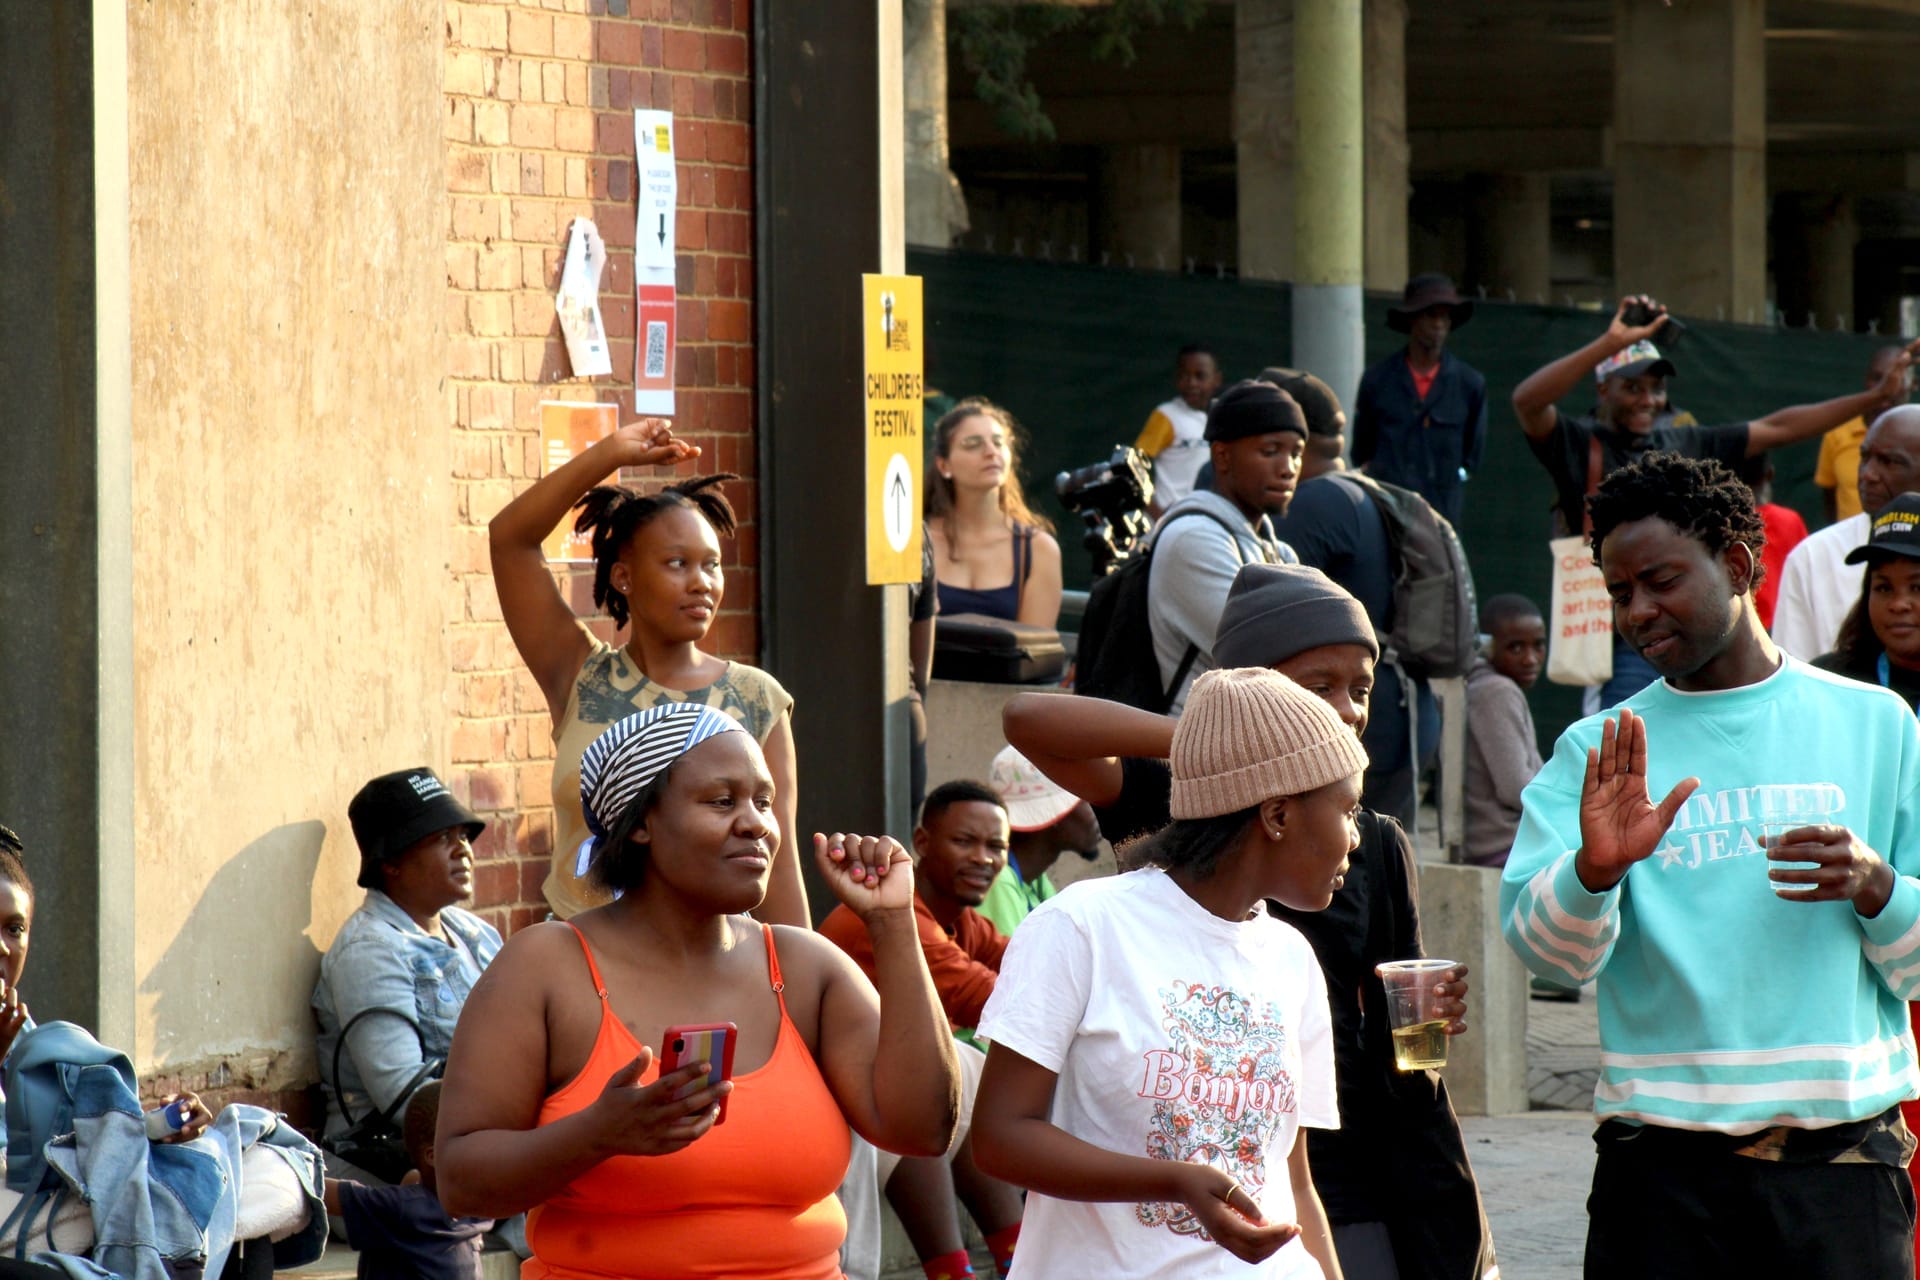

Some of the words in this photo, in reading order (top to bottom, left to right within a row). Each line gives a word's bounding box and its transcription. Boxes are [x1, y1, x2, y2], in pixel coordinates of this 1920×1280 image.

[1562, 619, 1588, 637] and
[1686, 819, 1785, 870] JEA
[1137, 1049, 1297, 1122] Bonjou
